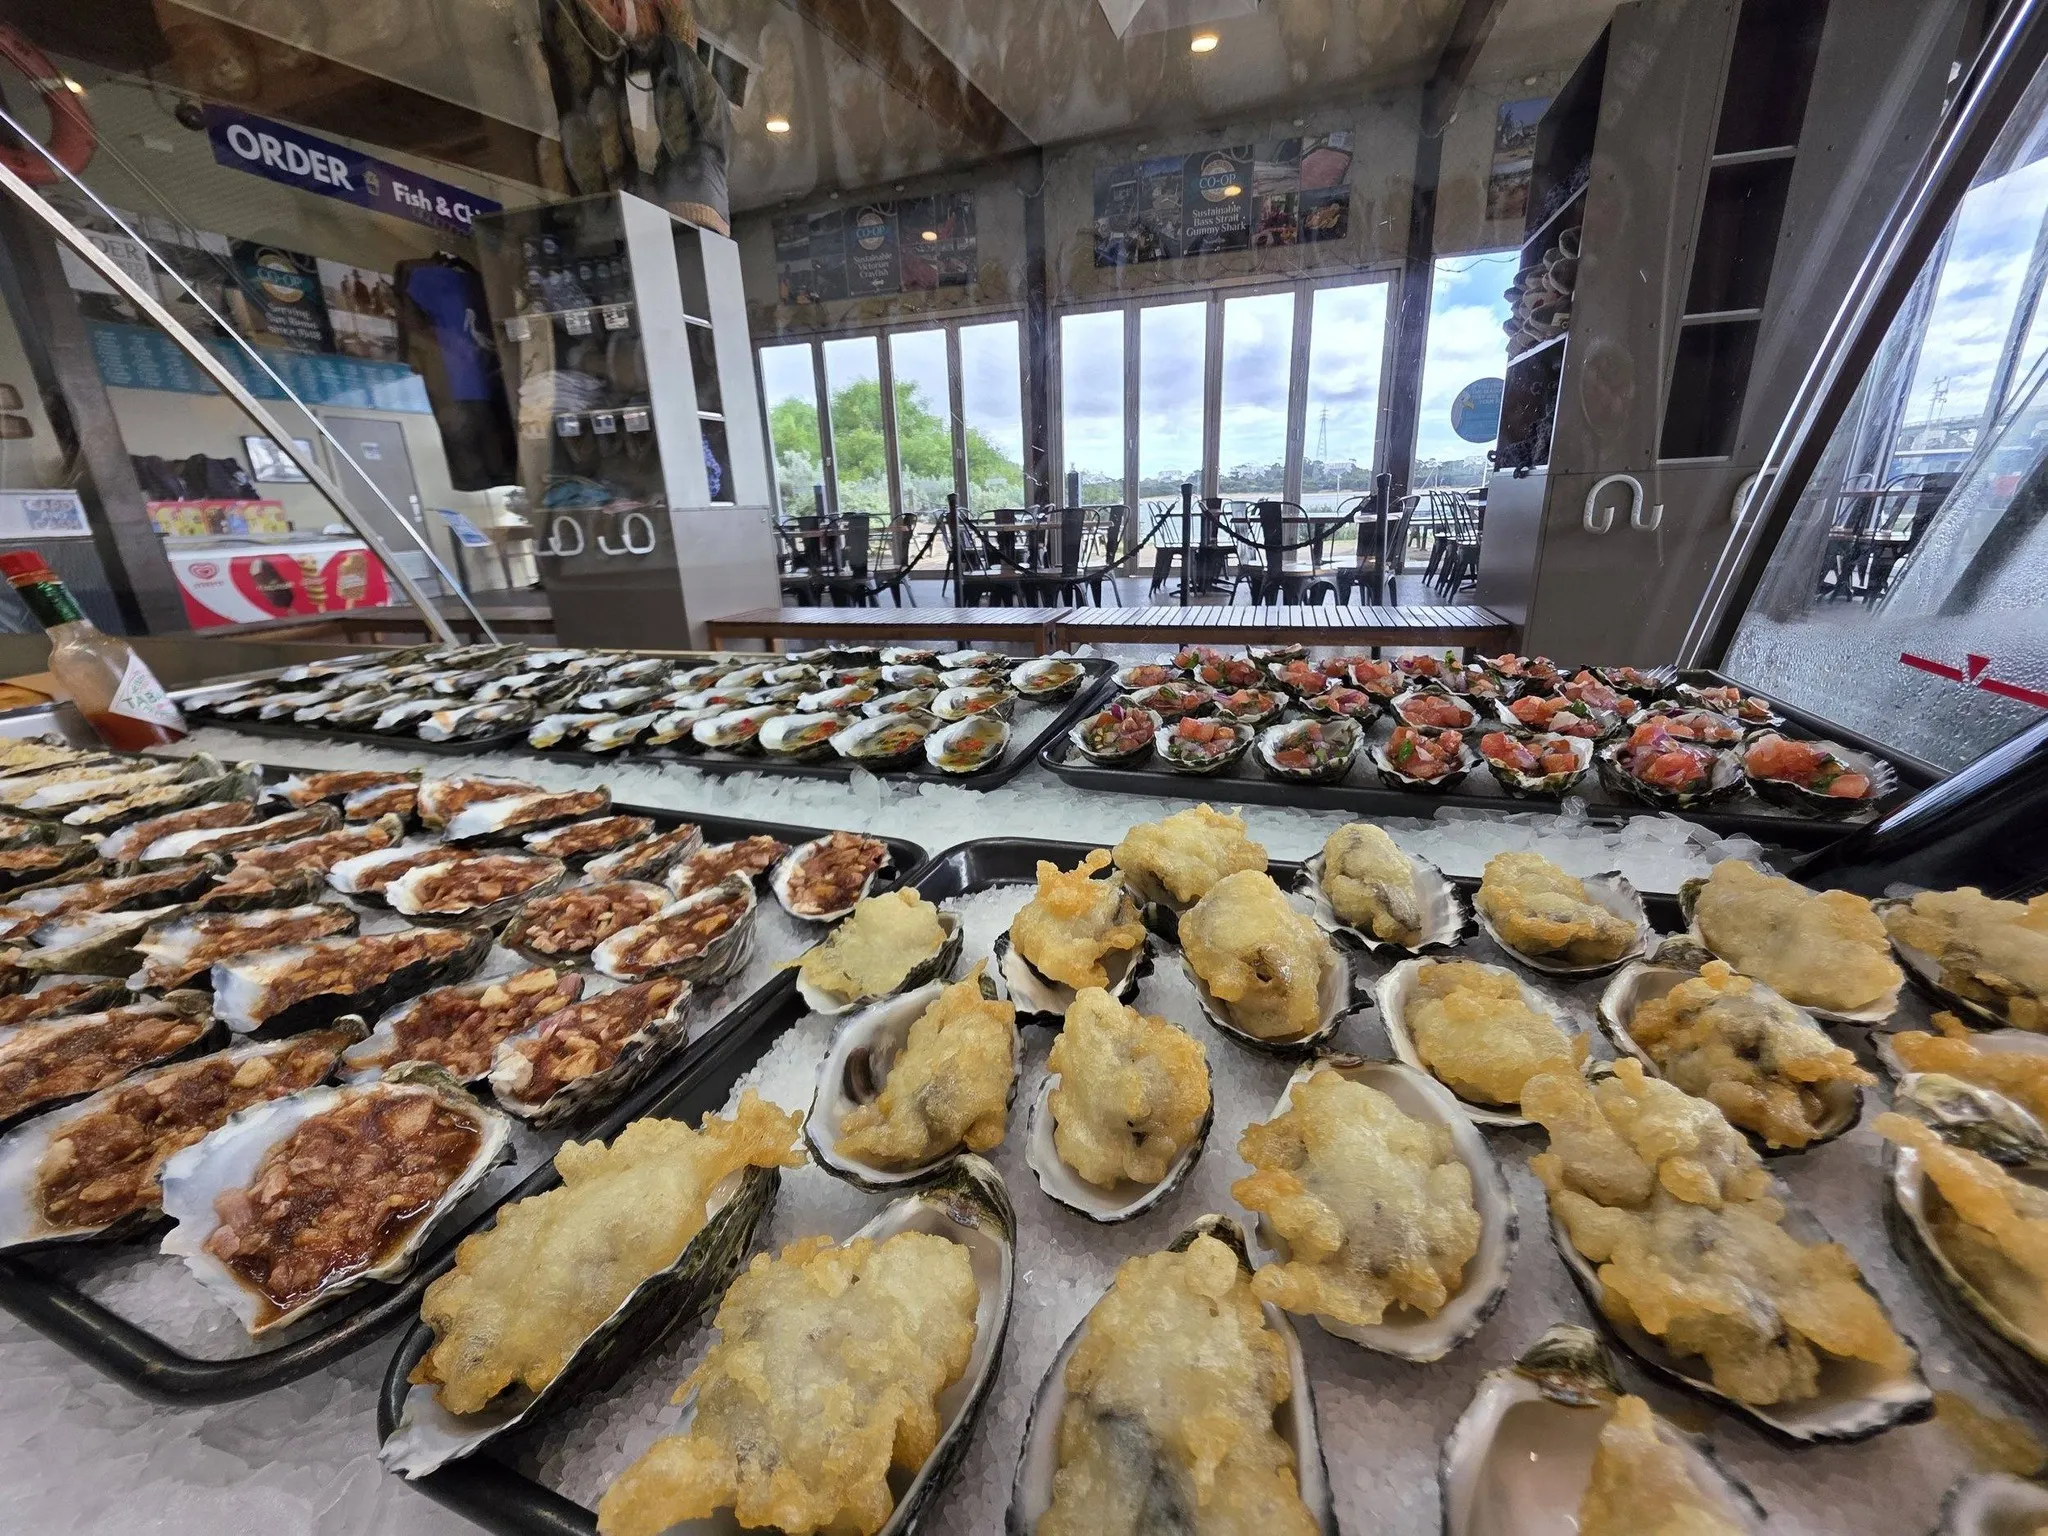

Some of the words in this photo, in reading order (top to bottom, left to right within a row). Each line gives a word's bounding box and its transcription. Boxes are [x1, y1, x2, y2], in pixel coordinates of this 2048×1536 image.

[226, 124, 354, 191] ORDER
[392, 181, 432, 212] Fish
[436, 197, 452, 219] &
[1200, 173, 1236, 188] CO-OP
[1192, 205, 1241, 217] Sustainable
[1193, 217, 1214, 227] Bass
[1215, 213, 1240, 224] Strait
[1186, 226, 1220, 237] Gummy
[1220, 220, 1246, 232] Shark
